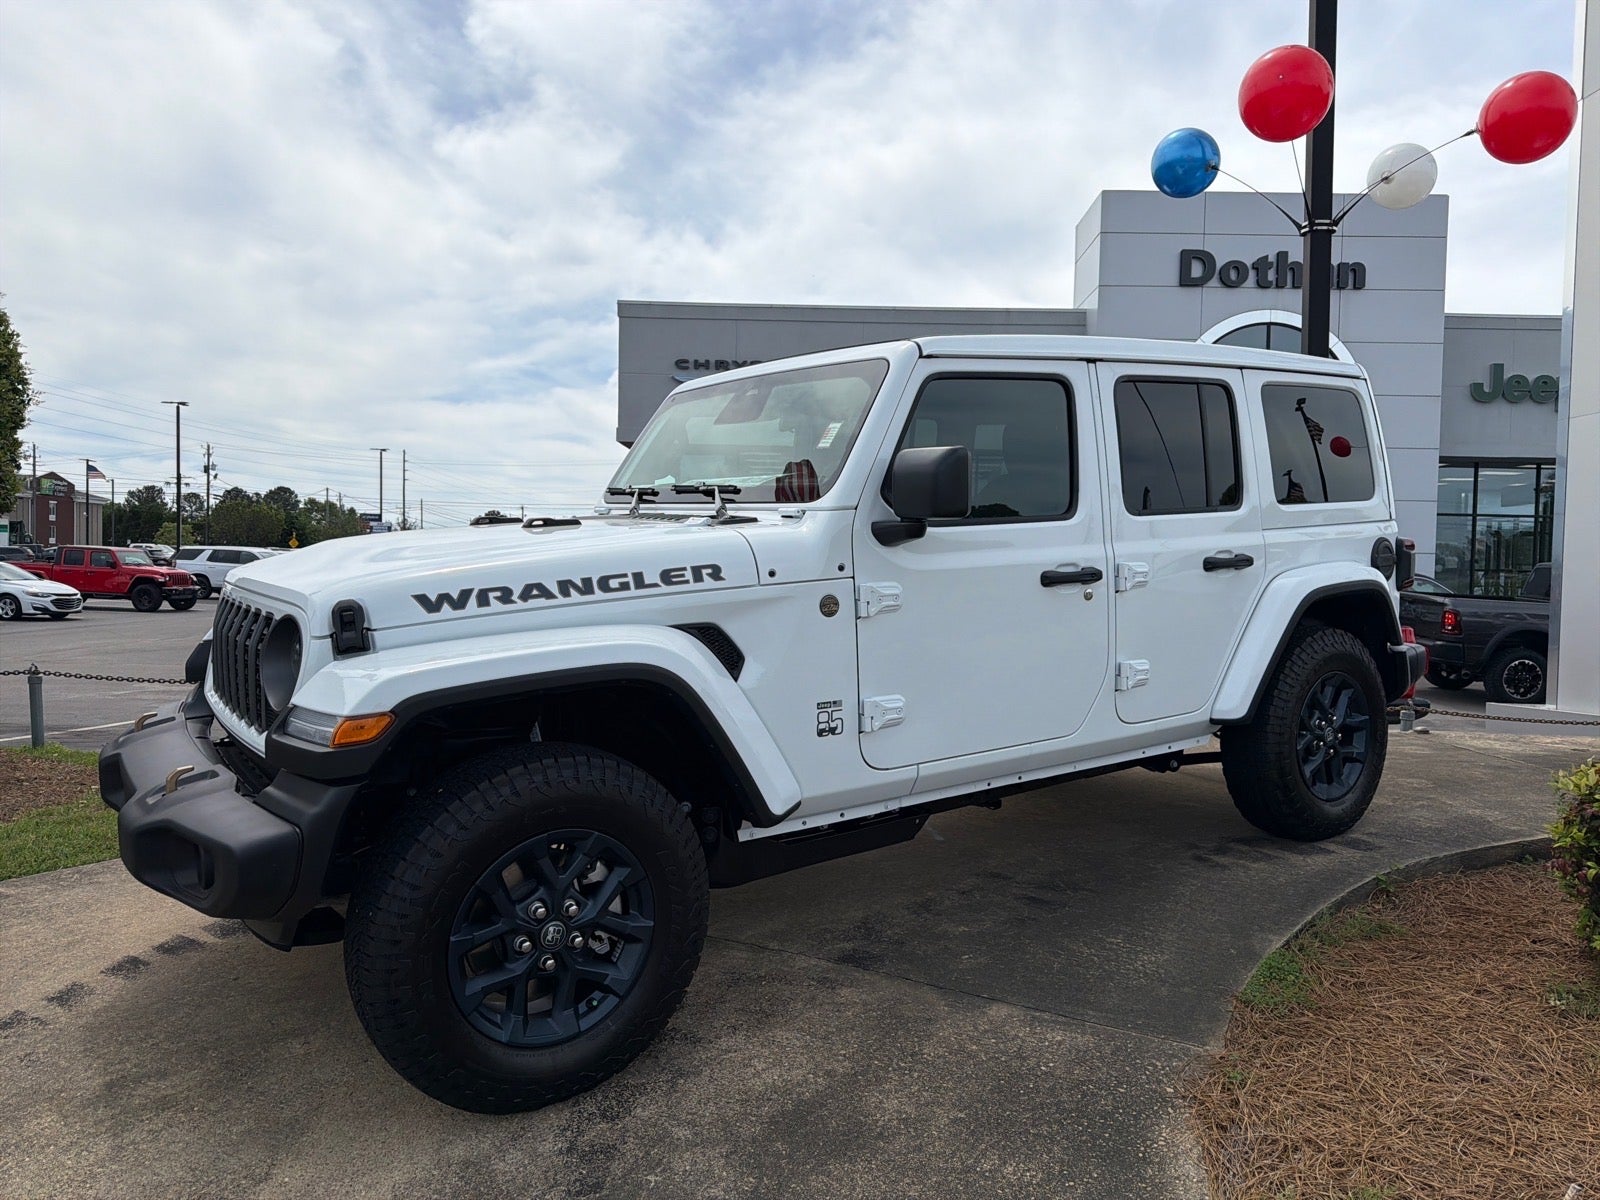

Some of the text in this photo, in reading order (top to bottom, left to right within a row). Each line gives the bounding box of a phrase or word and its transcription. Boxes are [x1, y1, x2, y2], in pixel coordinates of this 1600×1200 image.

[1180, 249, 1366, 289] Dothn
[410, 563, 727, 614] WRANGLER
[817, 709, 843, 737] 85
